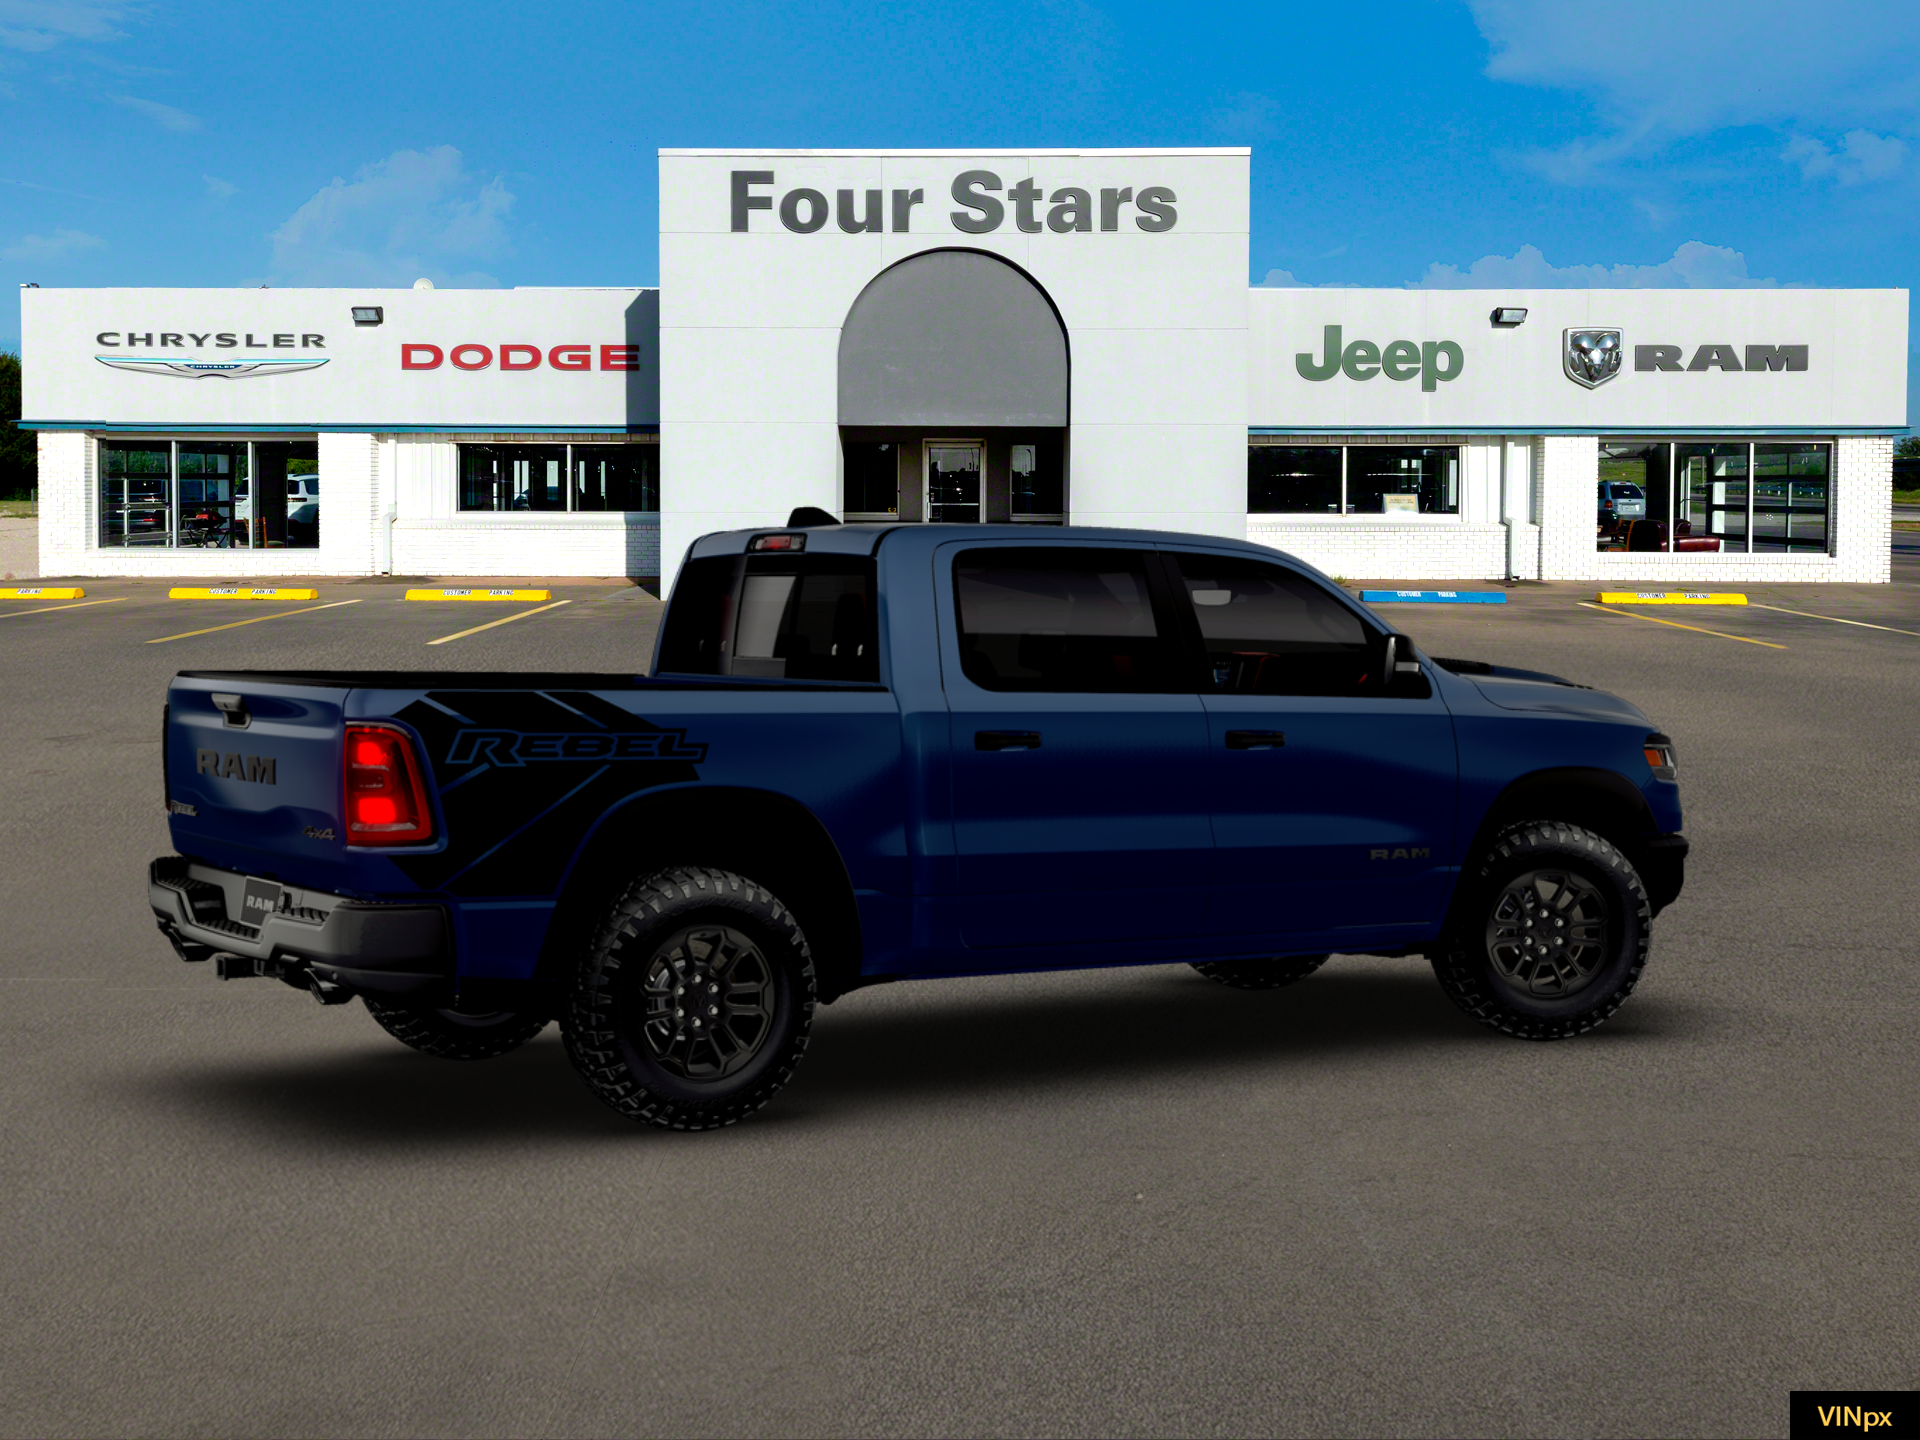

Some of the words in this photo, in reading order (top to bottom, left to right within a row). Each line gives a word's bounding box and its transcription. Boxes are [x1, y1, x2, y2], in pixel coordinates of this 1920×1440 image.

[731, 170, 924, 233] Four
[950, 170, 1178, 233] Stars
[96, 332, 326, 348] CHRYSLER
[401, 343, 640, 371] DODGE
[1295, 325, 1464, 392] Jeep
[1635, 344, 1809, 372] RAM
[444, 728, 708, 767] REBEL
[196, 747, 276, 786] RAM
[302, 825, 336, 841] 4x4
[1369, 847, 1431, 860] RAM
[246, 895, 275, 912] RAM
